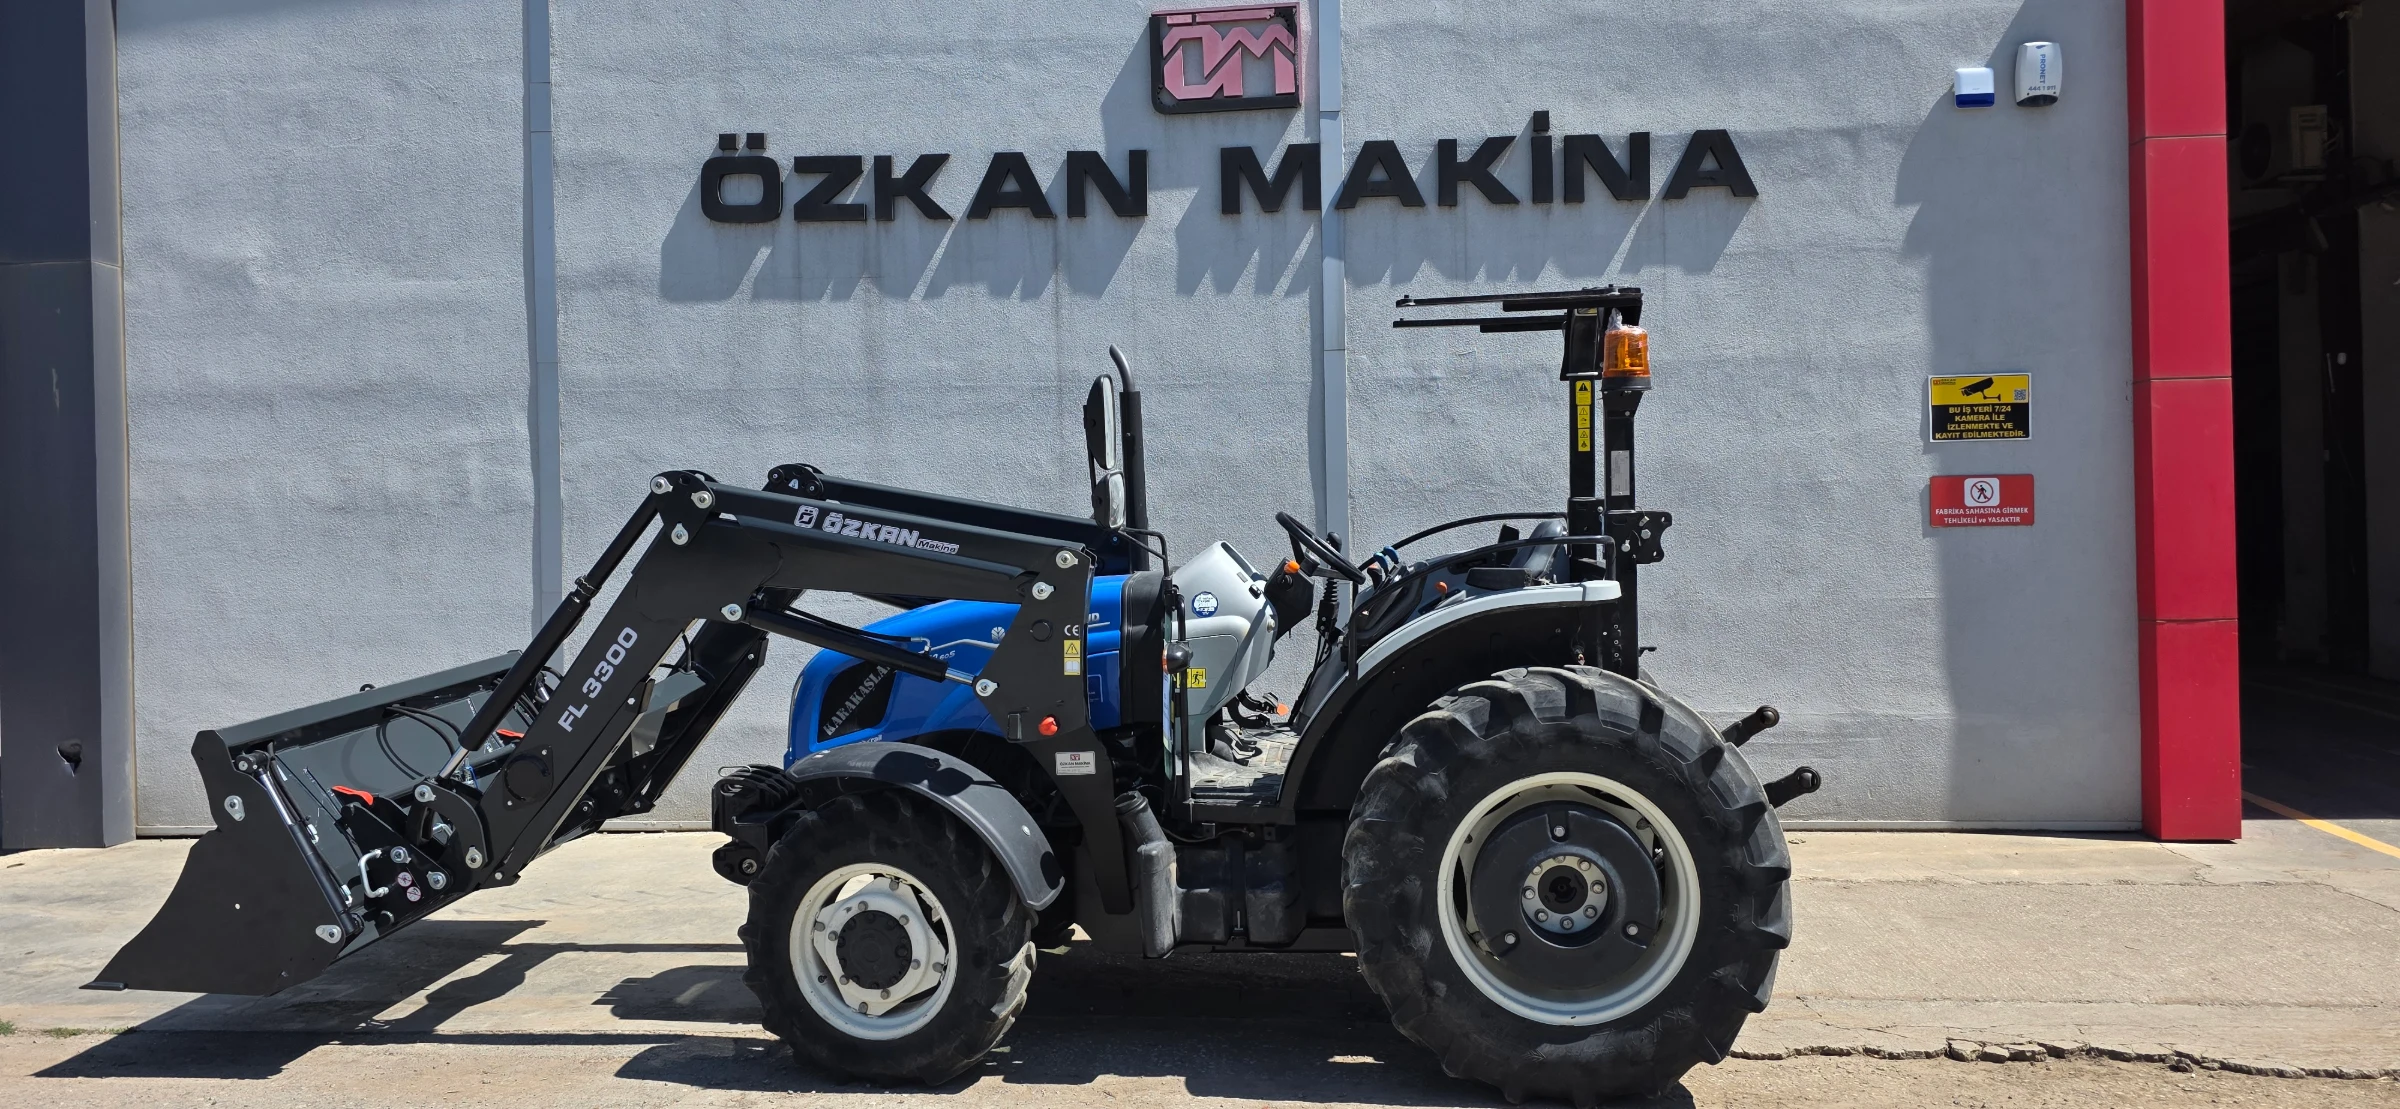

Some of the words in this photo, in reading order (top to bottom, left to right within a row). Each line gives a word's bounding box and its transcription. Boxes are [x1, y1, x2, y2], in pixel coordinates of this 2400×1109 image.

[700, 133, 1148, 223] ÖZKAN
[1220, 110, 1759, 215] MAKİNA
[1948, 406, 1961, 414] BU
[1962, 405, 1971, 414] İŞ
[1994, 405, 2012, 413] 7/24
[1954, 414, 1991, 422] KAMERA
[1992, 413, 2006, 421] İLE
[1962, 430, 2026, 438] EDİLMEKTEDİR.
[1965, 507, 2001, 515] SAHASINA
[2002, 506, 2029, 514] GİRMEK
[822, 512, 919, 548] ÖZKAN
[917, 539, 958, 554] Makina
[557, 703, 589, 732] FL
[582, 626, 638, 699] 3300
